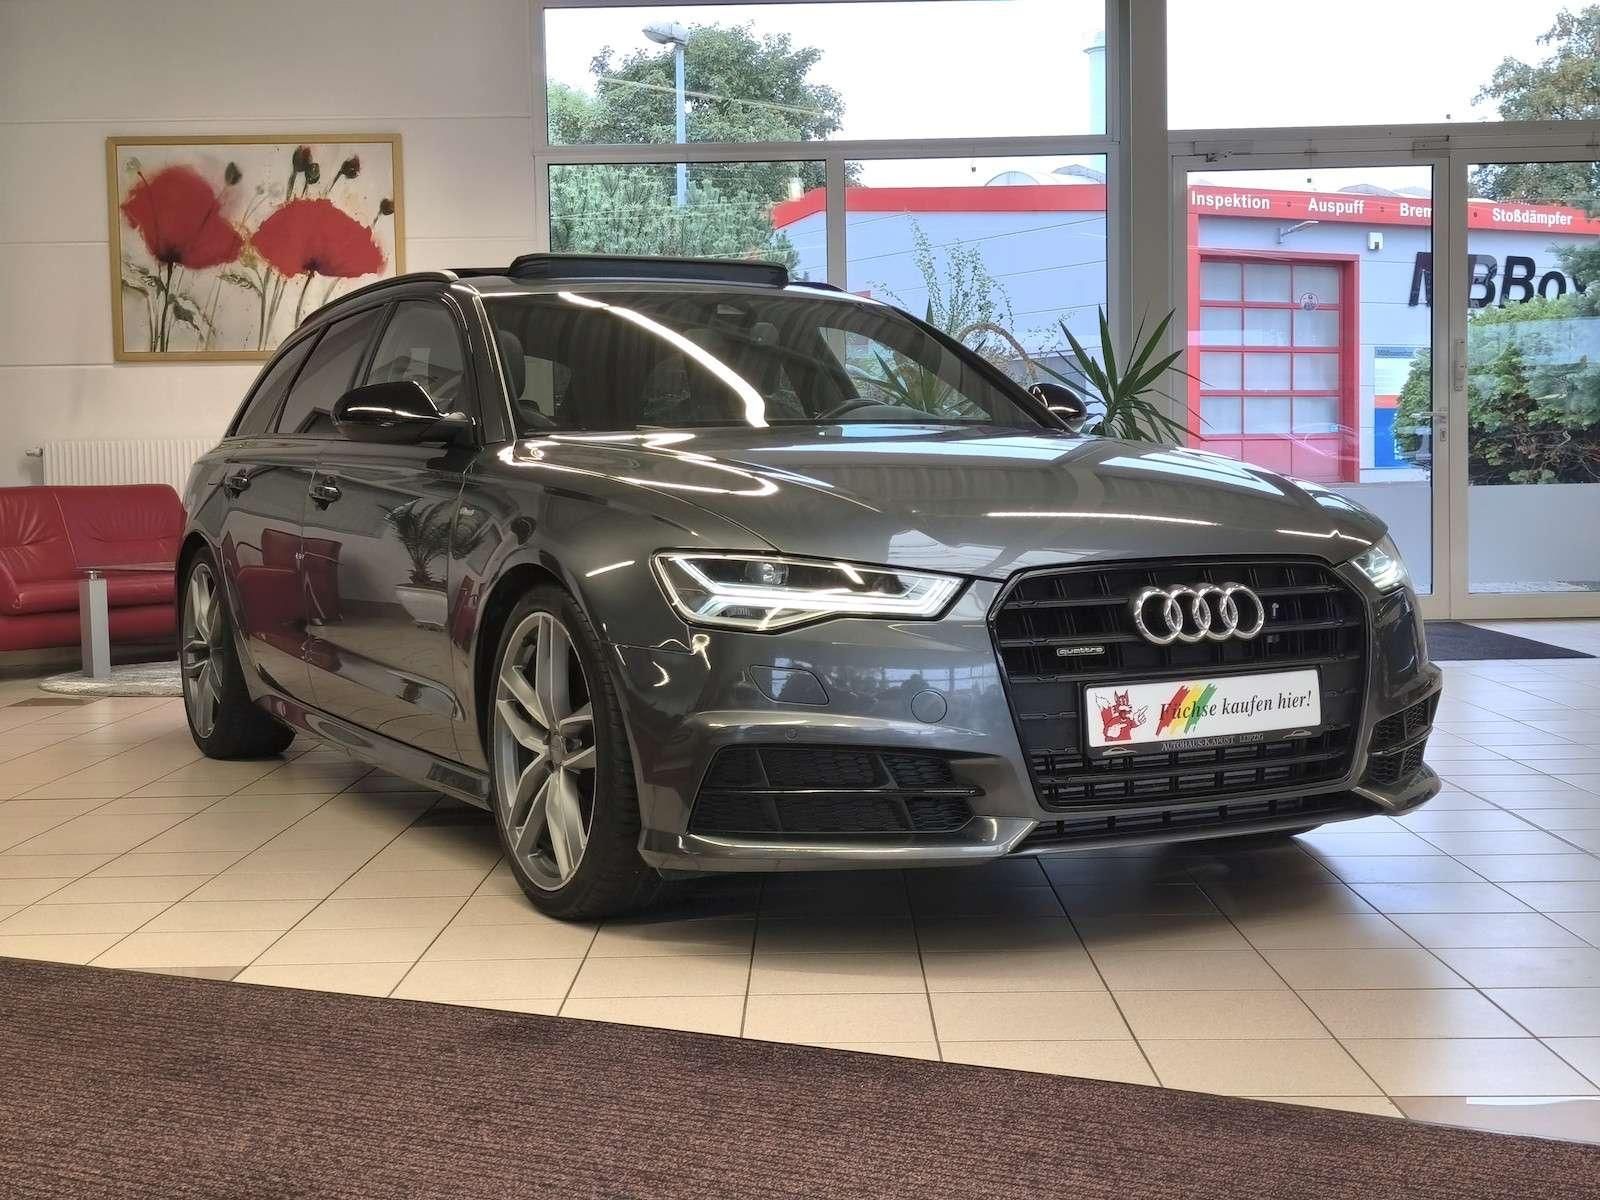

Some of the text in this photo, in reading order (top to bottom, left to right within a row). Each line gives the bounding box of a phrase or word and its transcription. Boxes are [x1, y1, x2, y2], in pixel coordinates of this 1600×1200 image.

[1191, 190, 1573, 228] Inspektion Auspuff Brem Stoßdämpfer
[1222, 694, 1273, 718] kaufen
[1278, 690, 1312, 710] hier!
